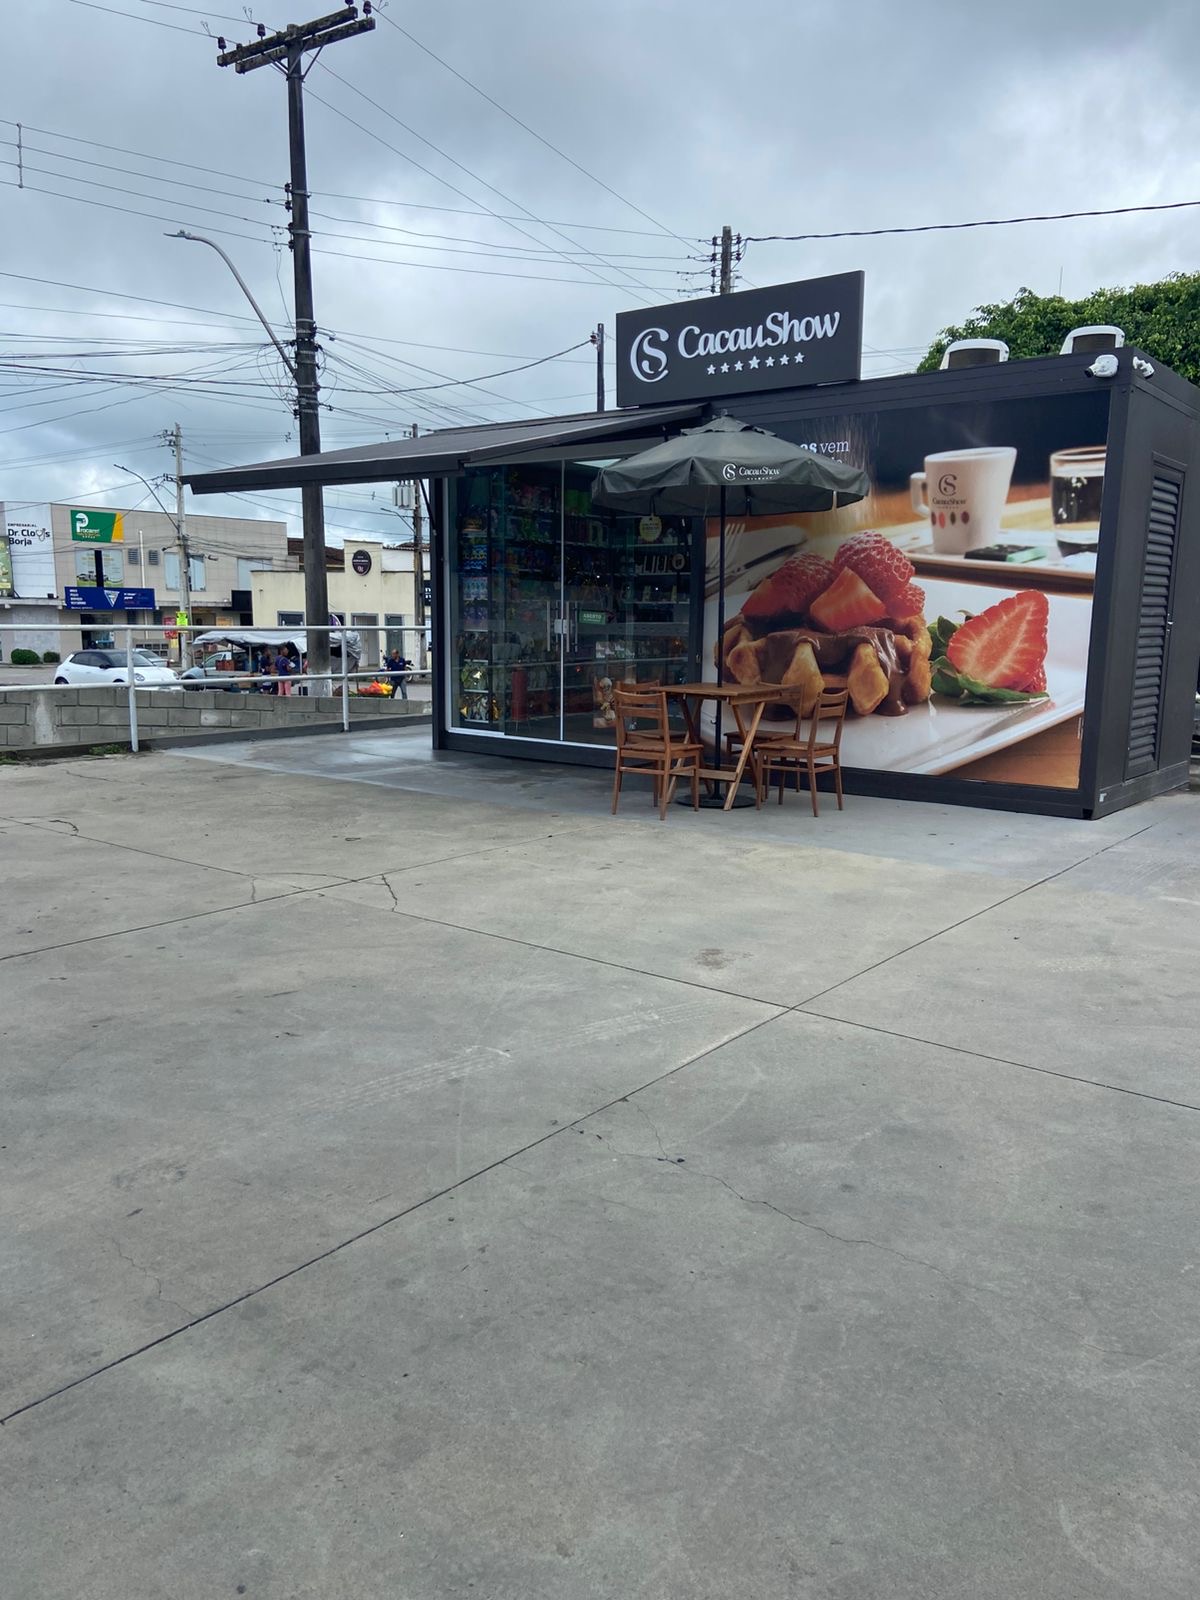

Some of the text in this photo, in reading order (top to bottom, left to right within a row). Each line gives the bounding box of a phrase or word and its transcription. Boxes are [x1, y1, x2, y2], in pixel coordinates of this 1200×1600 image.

[819, 441, 849, 453] vem
[7, 529, 20, 537] Dr.
[8, 537, 33, 546] Borja
